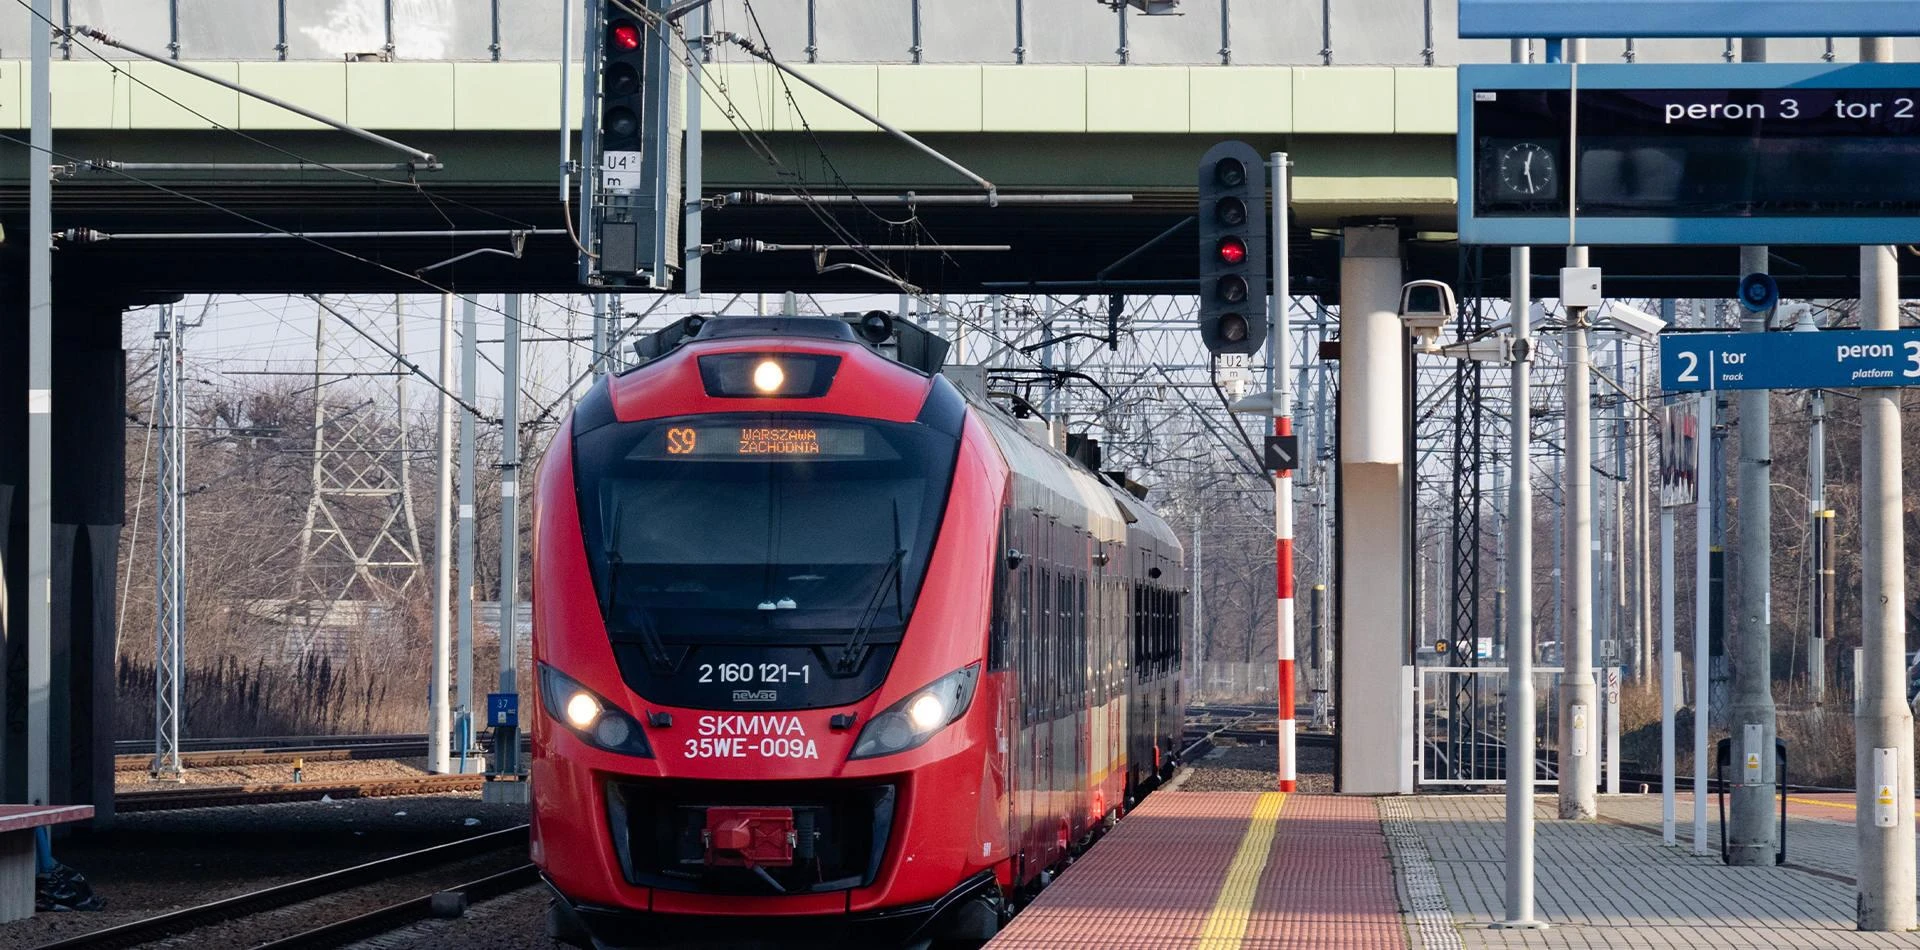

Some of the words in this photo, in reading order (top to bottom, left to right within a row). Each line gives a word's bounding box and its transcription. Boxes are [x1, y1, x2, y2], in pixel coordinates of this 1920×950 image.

[1665, 101, 1765, 124] peron
[1779, 99, 1800, 119] 3
[1834, 99, 1882, 119] tor
[1894, 98, 1914, 119] 2
[607, 177, 621, 186] m
[1226, 355, 1242, 367] U2
[1721, 351, 1747, 364] tor
[1837, 344, 1894, 362] peron
[1903, 340, 1920, 378] 3
[1677, 351, 1699, 382] 2
[1722, 372, 1744, 381] track
[1851, 368, 1894, 380] platform
[667, 428, 696, 454] S9
[742, 428, 816, 441] WARSZAWA
[739, 441, 819, 454] ZACHODNIA
[698, 664, 713, 683] 2
[718, 663, 754, 683] 160
[758, 663, 809, 684] 121-1
[698, 715, 806, 736] SKMWA
[684, 738, 819, 760] 35WE-009A
